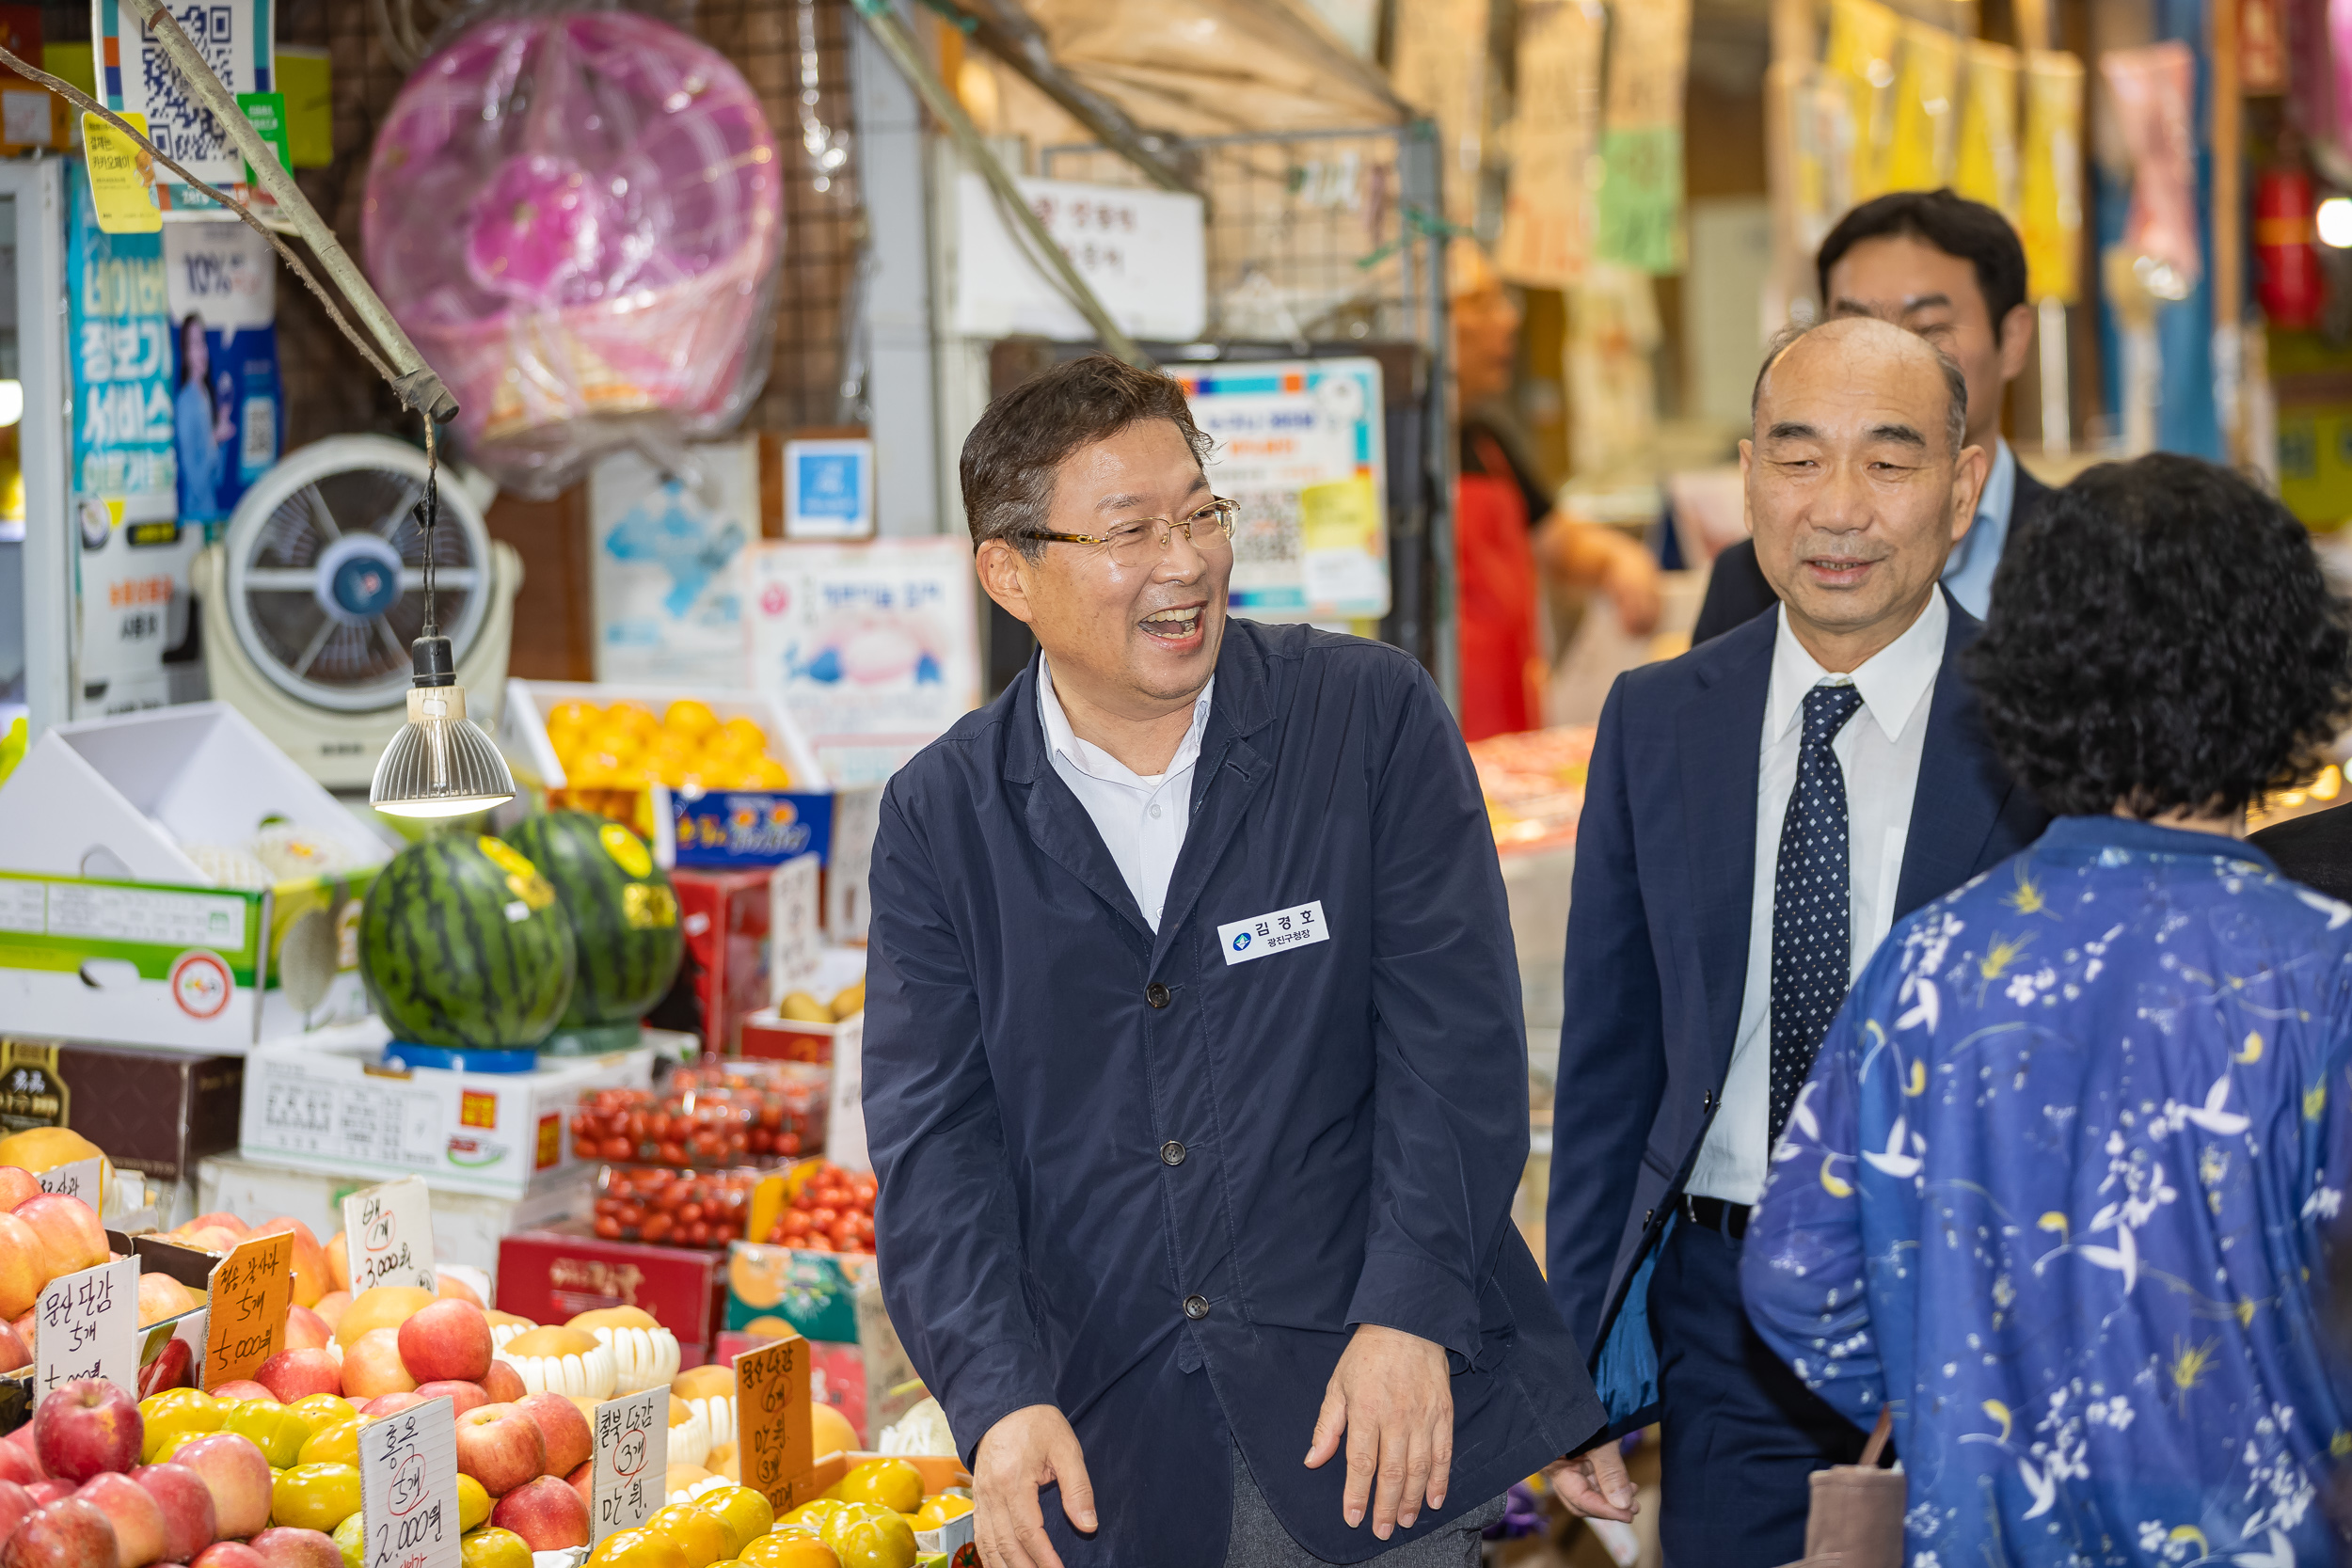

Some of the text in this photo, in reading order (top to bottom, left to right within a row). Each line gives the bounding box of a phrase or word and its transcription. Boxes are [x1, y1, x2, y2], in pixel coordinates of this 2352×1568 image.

[92, 154, 130, 170] 카카오페이
[83, 256, 167, 317] 네이버
[79, 316, 173, 382] 장보기
[82, 379, 175, 446] 서비스
[1267, 928, 1311, 948] 광진구청장
[236, 1288, 265, 1322] 5개
[69, 1321, 97, 1351] 5개
[627, 1397, 653, 1431] 단감
[379, 1416, 419, 1469] 홍옥
[618, 1437, 644, 1473] 3개
[393, 1467, 421, 1504] 5개
